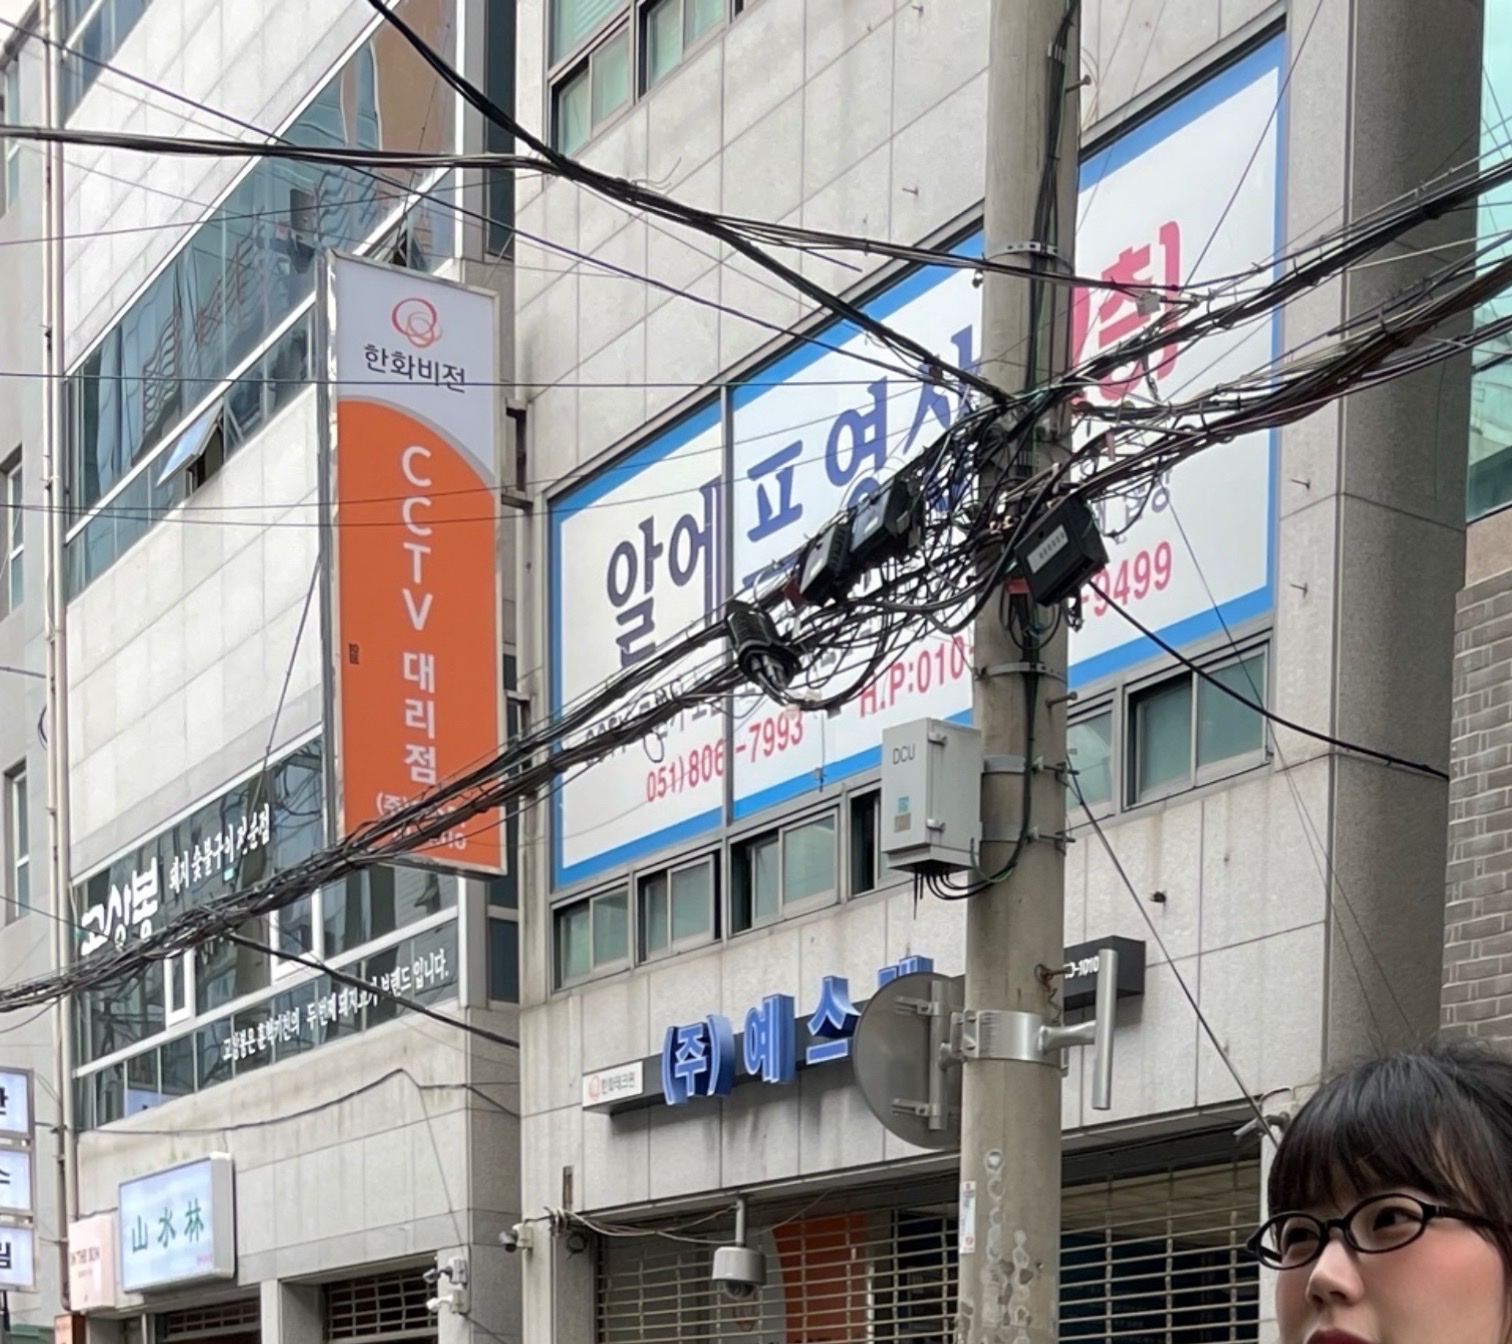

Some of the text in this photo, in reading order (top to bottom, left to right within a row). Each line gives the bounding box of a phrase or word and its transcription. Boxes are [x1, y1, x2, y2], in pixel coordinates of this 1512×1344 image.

[363, 342, 467, 394] 한화비전
[402, 445, 437, 785] CCTV 대리점
[892, 744, 917, 766] DCU
[81, 856, 159, 956] 고상봉
[413, 947, 450, 991] 입니다.
[131, 1197, 205, 1254] 山水林
